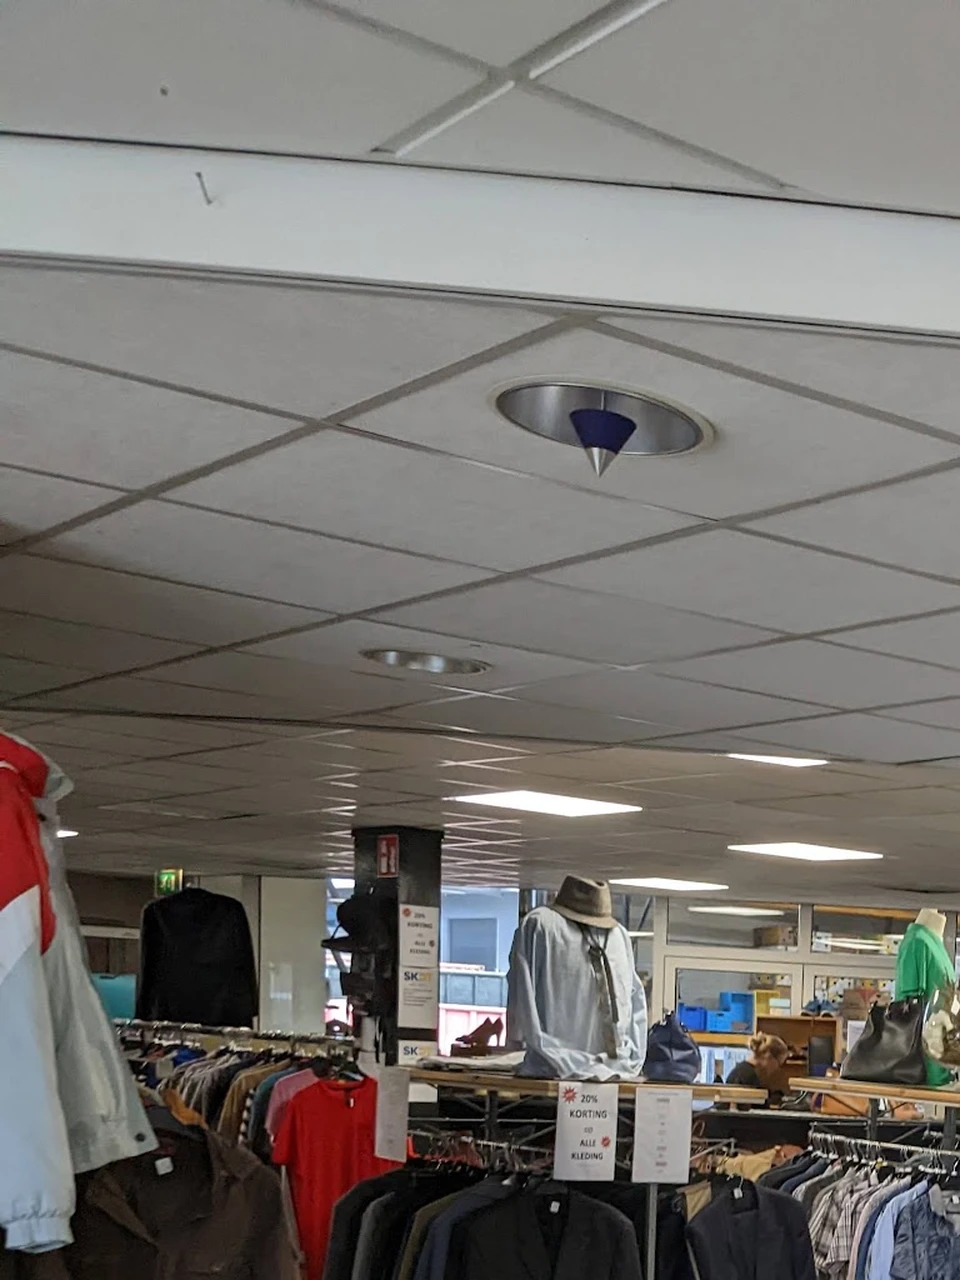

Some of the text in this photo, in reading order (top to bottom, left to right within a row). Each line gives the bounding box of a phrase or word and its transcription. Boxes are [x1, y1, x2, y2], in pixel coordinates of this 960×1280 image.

[580, 1094, 599, 1104] 20%
[569, 1109, 608, 1119] KORTING
[580, 1139, 596, 1148] ALLE
[571, 1152, 604, 1160] KLEDING
